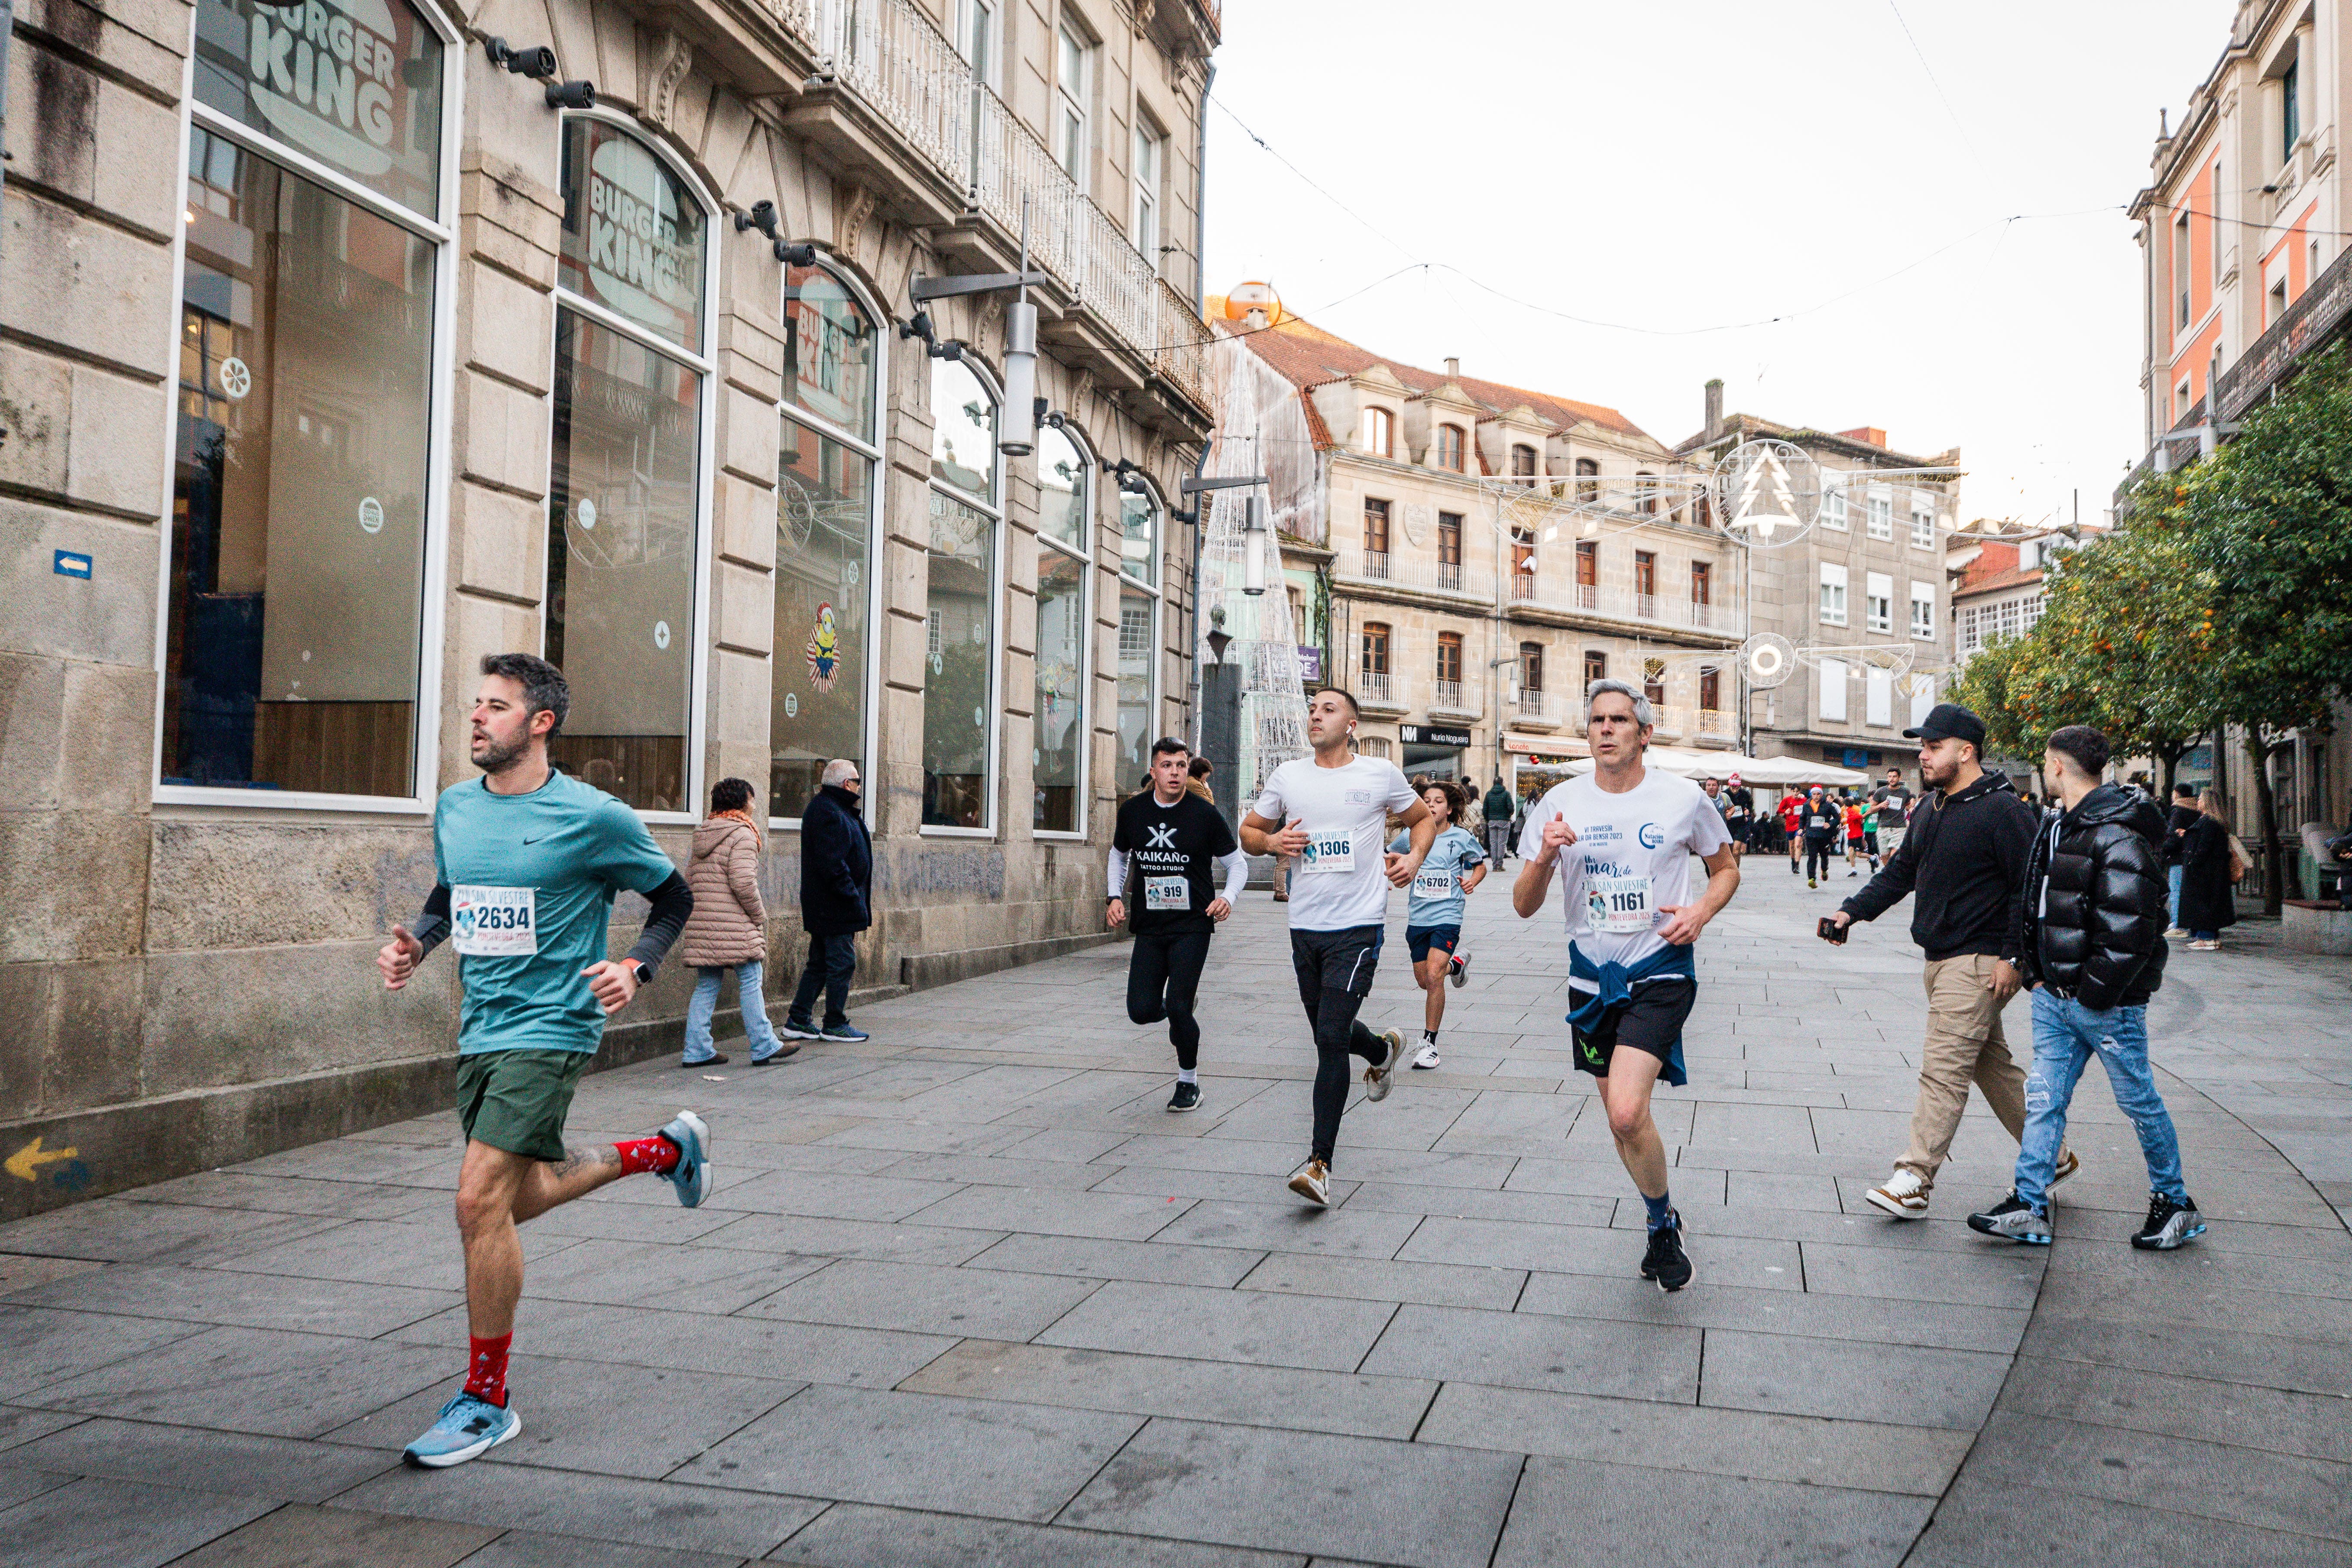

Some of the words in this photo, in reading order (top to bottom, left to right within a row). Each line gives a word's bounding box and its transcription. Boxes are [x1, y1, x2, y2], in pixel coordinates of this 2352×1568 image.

[254, 0, 395, 89] URGER
[251, 13, 393, 146] KING
[589, 213, 676, 304] KING
[1432, 733, 1445, 741] Nuria
[1446, 734, 1468, 743] Nogueira
[1344, 790, 1371, 804] QUIKSILVER
[1590, 824, 1612, 832] TRAVESÍA
[1312, 833, 1322, 841] SAN
[1324, 831, 1350, 840] SILVESTRE
[1319, 840, 1350, 856] 1306
[1135, 851, 1189, 863] KAIKAÑO
[1584, 855, 1597, 864] Un
[1623, 865, 1632, 875] de
[1427, 878, 1449, 887] 6702
[1598, 880, 1612, 892] SAN
[1613, 878, 1648, 891] SILVESTRE
[1164, 886, 1182, 897] 919
[1610, 891, 1644, 911] 1161
[478, 906, 530, 929] 2634
[1608, 912, 1638, 921] PONTEVEDRA
[1639, 911, 1650, 920] 2025
